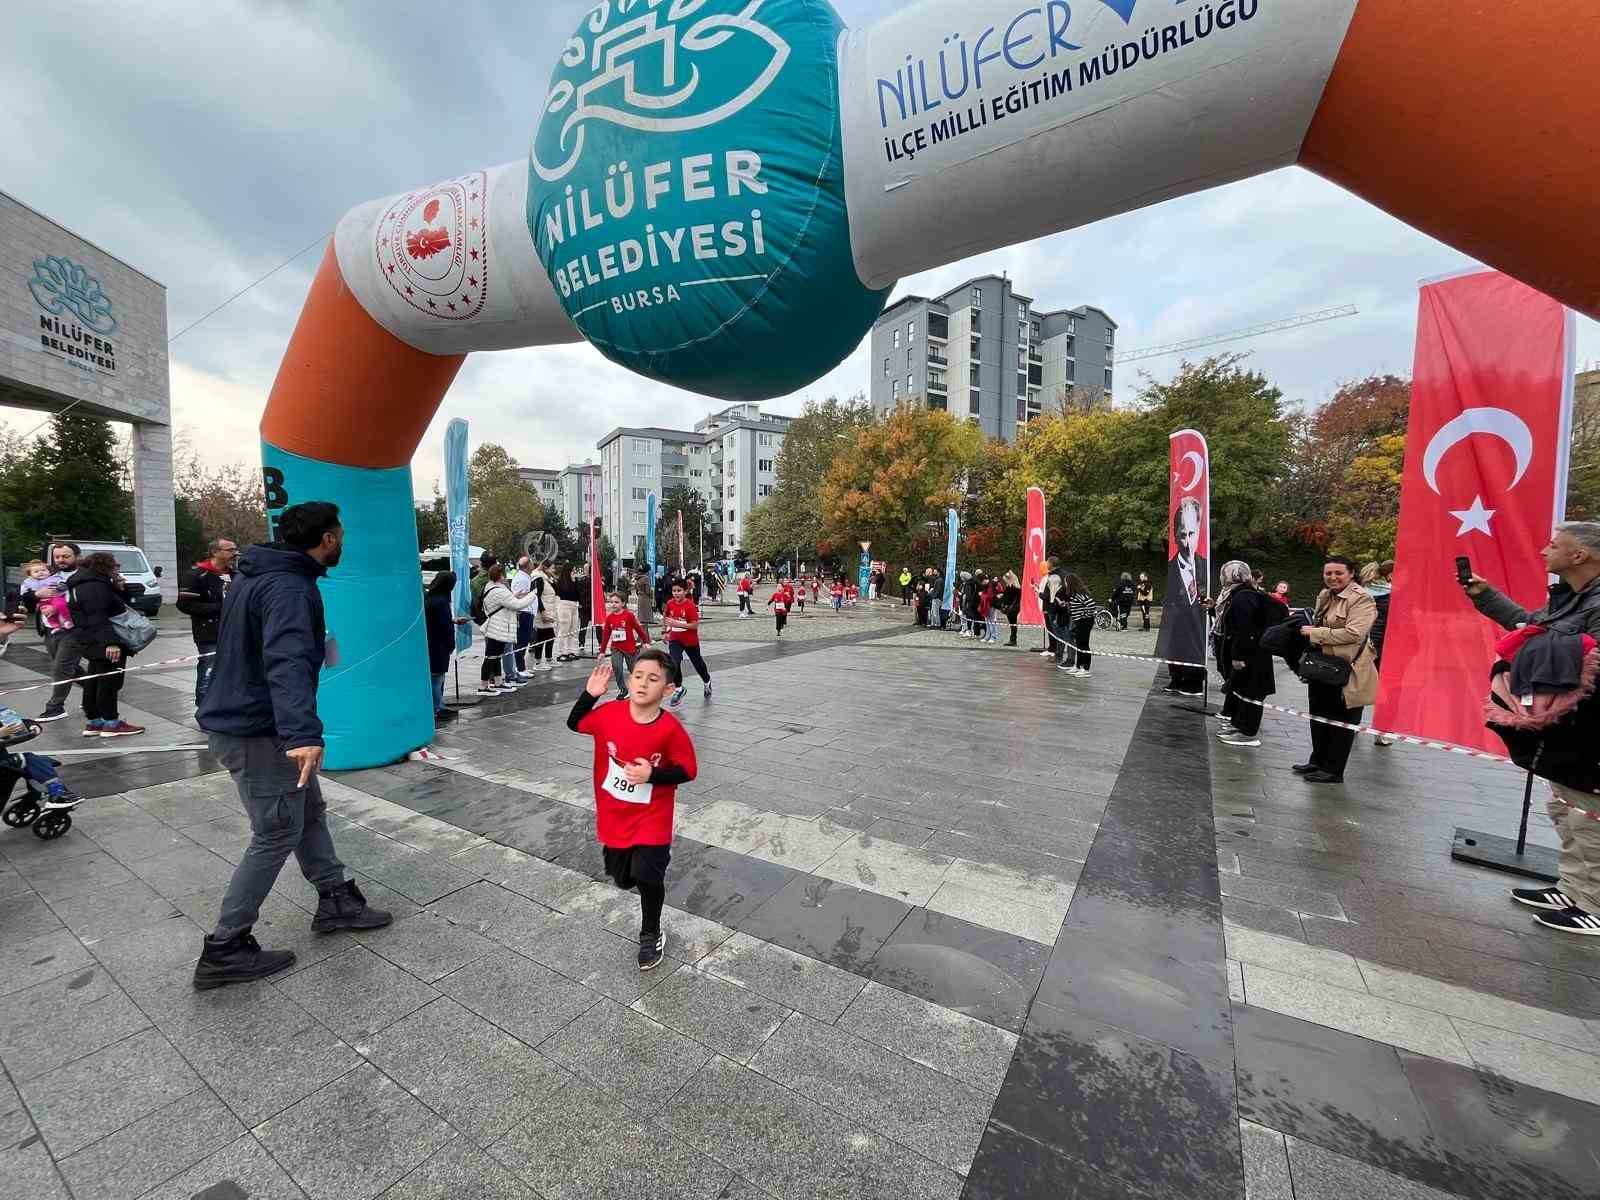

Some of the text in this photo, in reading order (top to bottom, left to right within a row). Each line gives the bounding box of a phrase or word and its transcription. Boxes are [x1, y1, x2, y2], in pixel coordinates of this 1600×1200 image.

[876, 1, 1083, 128] NİLÜFER
[883, 126, 928, 162] İLÇE
[931, 97, 987, 146] MİLLİ
[992, 68, 1073, 121] EĞİTİM
[546, 150, 769, 250] NİLÜFER
[555, 209, 766, 298] BELEDİYESİ
[40, 314, 114, 357] NİLÜFER
[611, 283, 681, 314] BURSA
[41, 334, 116, 371] BELEDİYESİ
